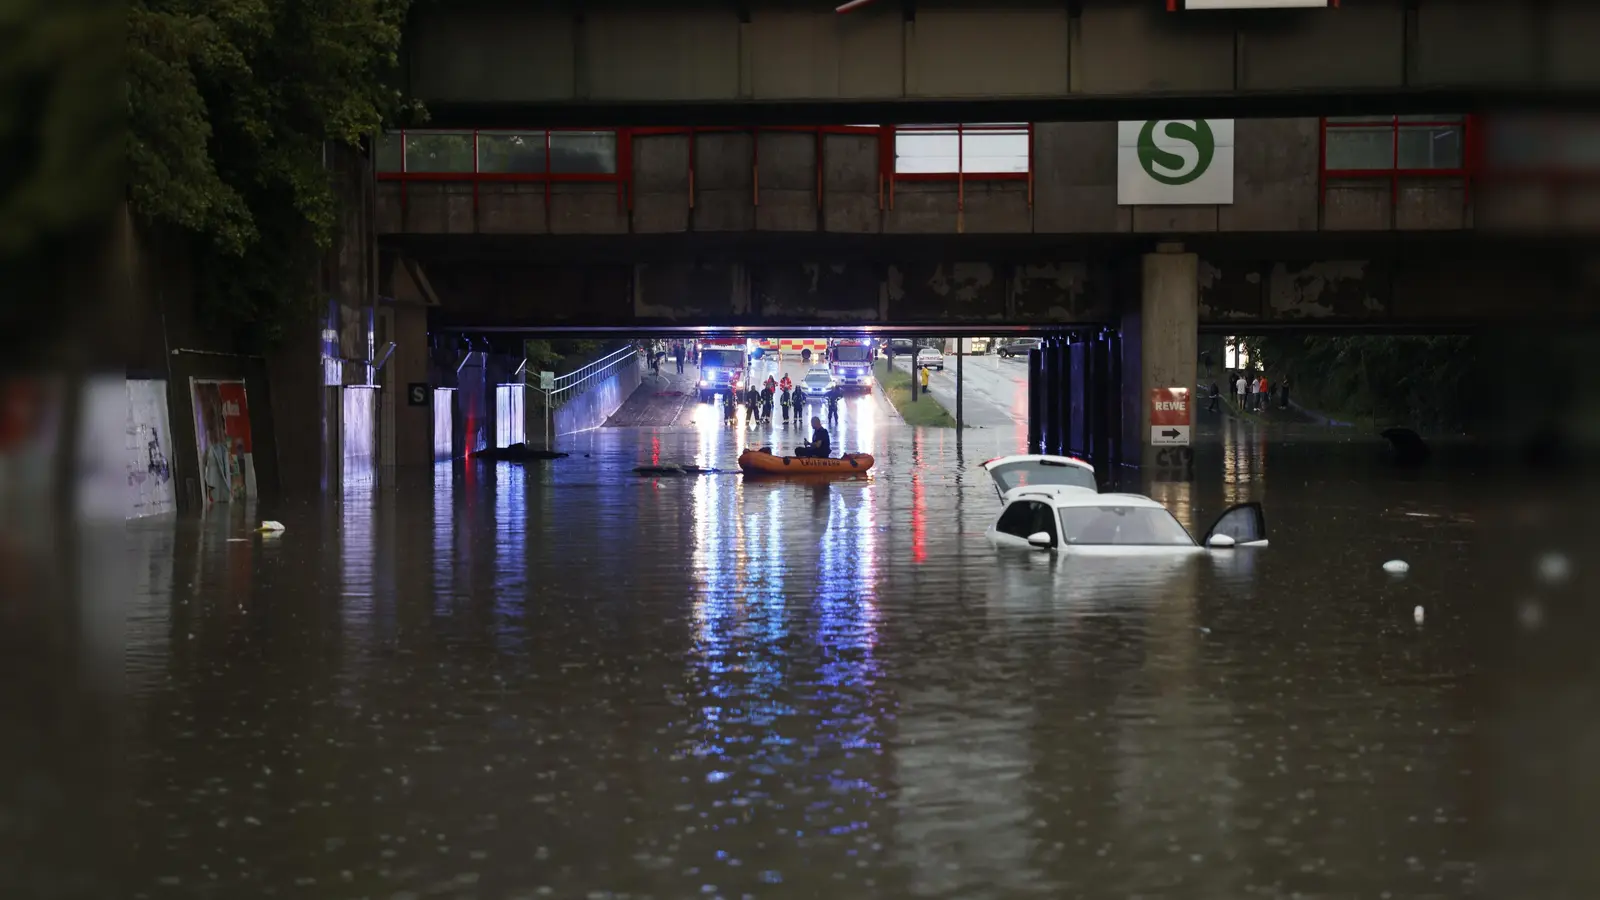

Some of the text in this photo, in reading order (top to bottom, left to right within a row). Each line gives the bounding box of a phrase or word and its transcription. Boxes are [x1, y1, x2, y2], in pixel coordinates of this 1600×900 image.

[1151, 119, 1200, 178] S
[414, 386, 424, 402] S
[1155, 401, 1186, 411] REWE
